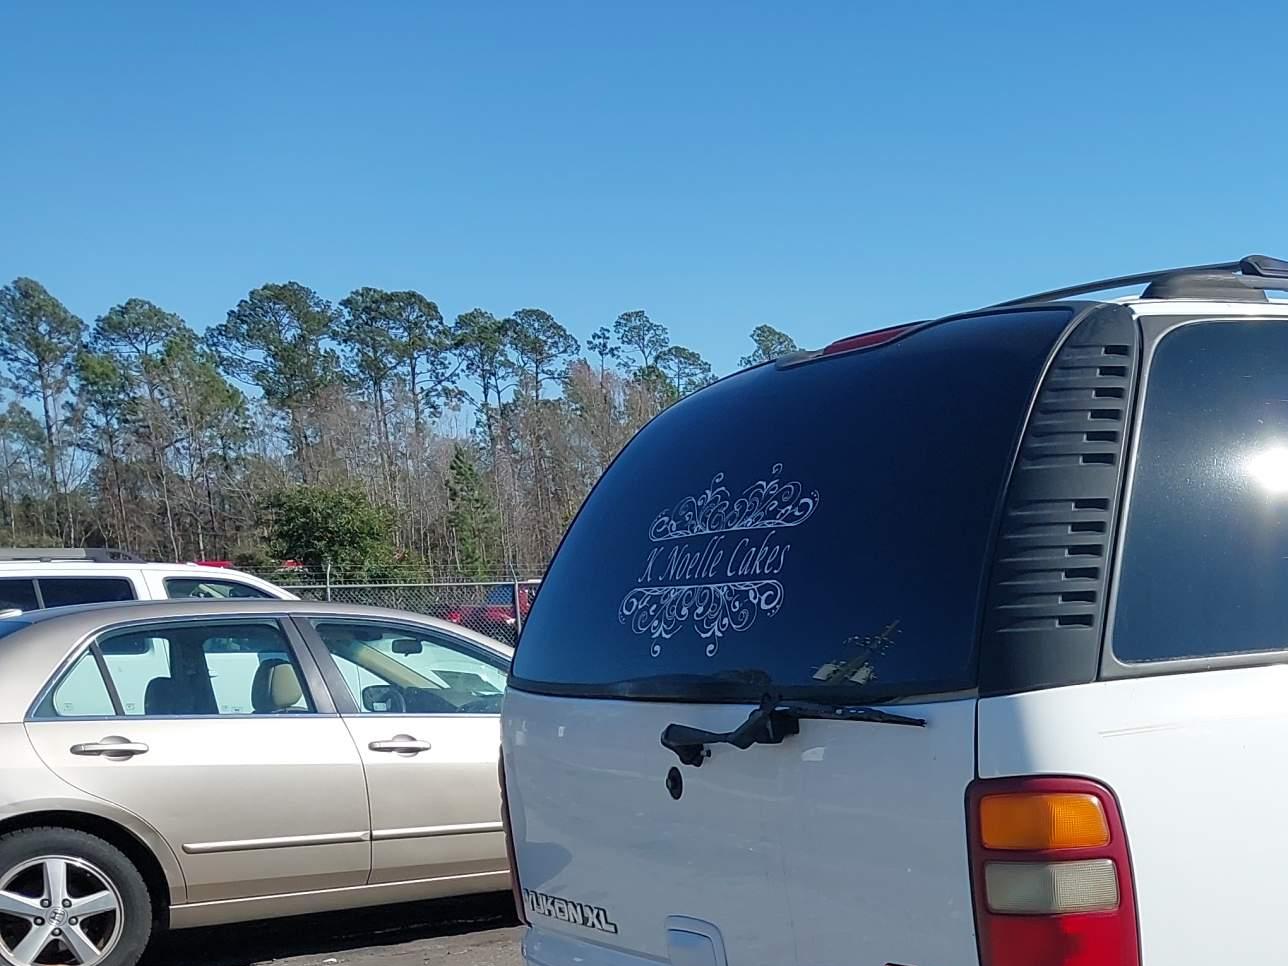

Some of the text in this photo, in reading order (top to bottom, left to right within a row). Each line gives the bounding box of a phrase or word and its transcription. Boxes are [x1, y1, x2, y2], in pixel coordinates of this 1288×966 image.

[659, 535, 725, 581] Noelle
[727, 530, 791, 577] Cakes
[583, 904, 618, 934] XL
